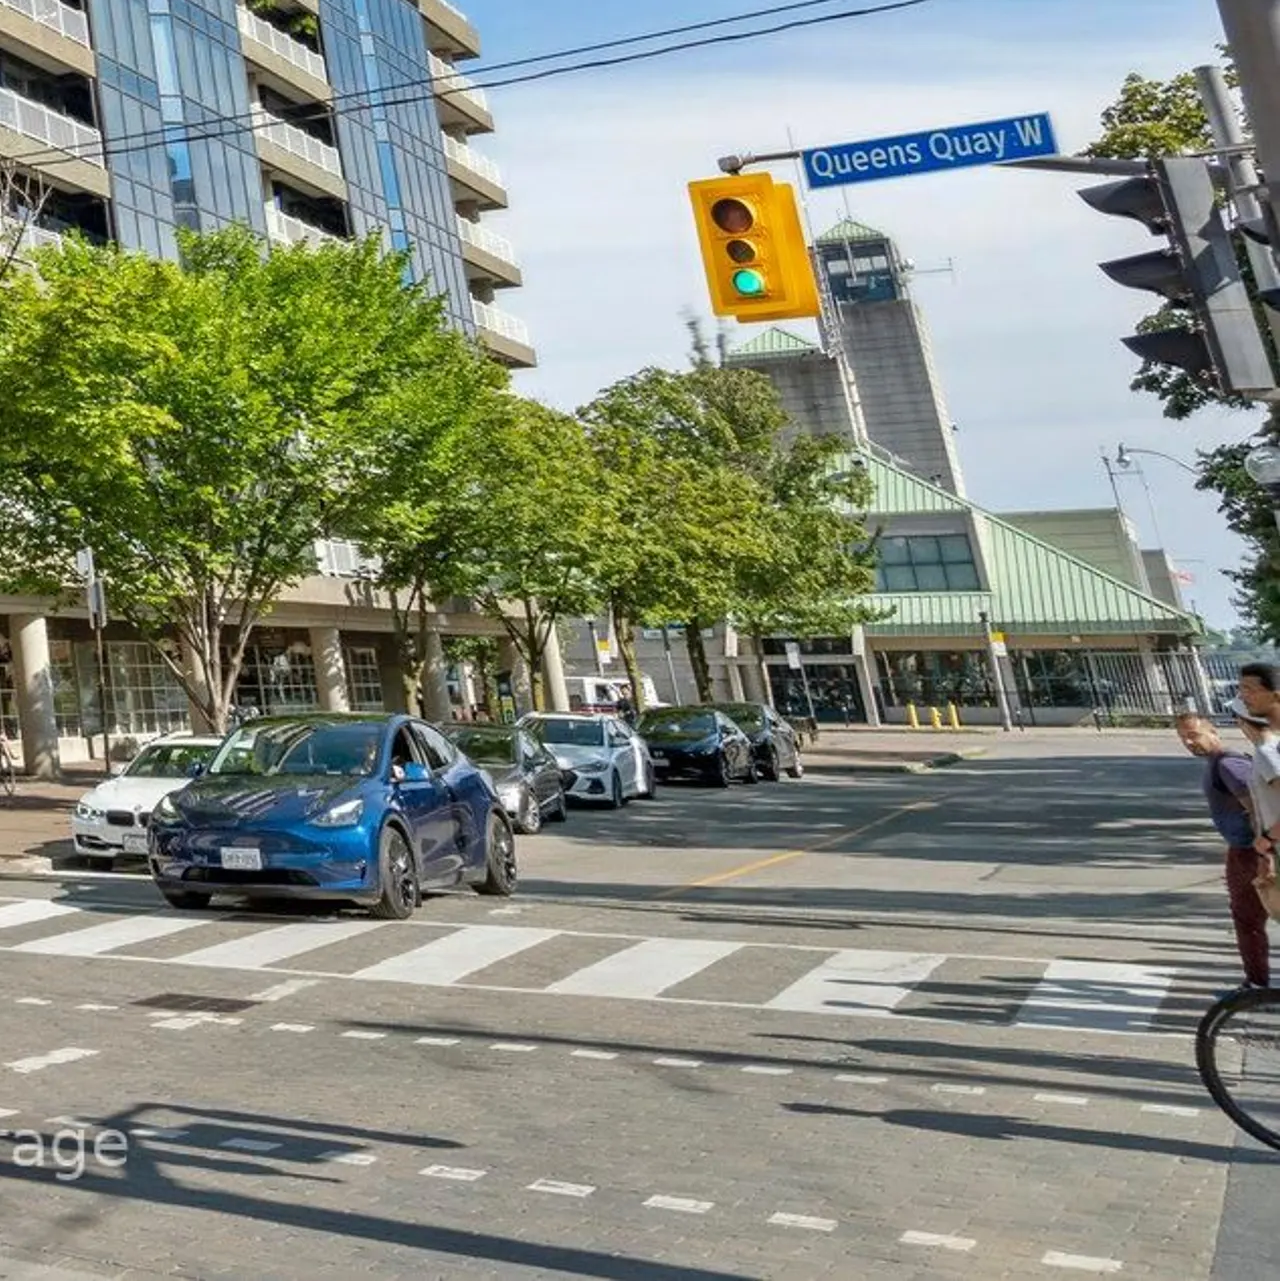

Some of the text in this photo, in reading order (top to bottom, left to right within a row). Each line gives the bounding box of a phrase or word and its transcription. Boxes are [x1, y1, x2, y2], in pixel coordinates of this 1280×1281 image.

[811, 117, 1043, 178] Queens Quay W
